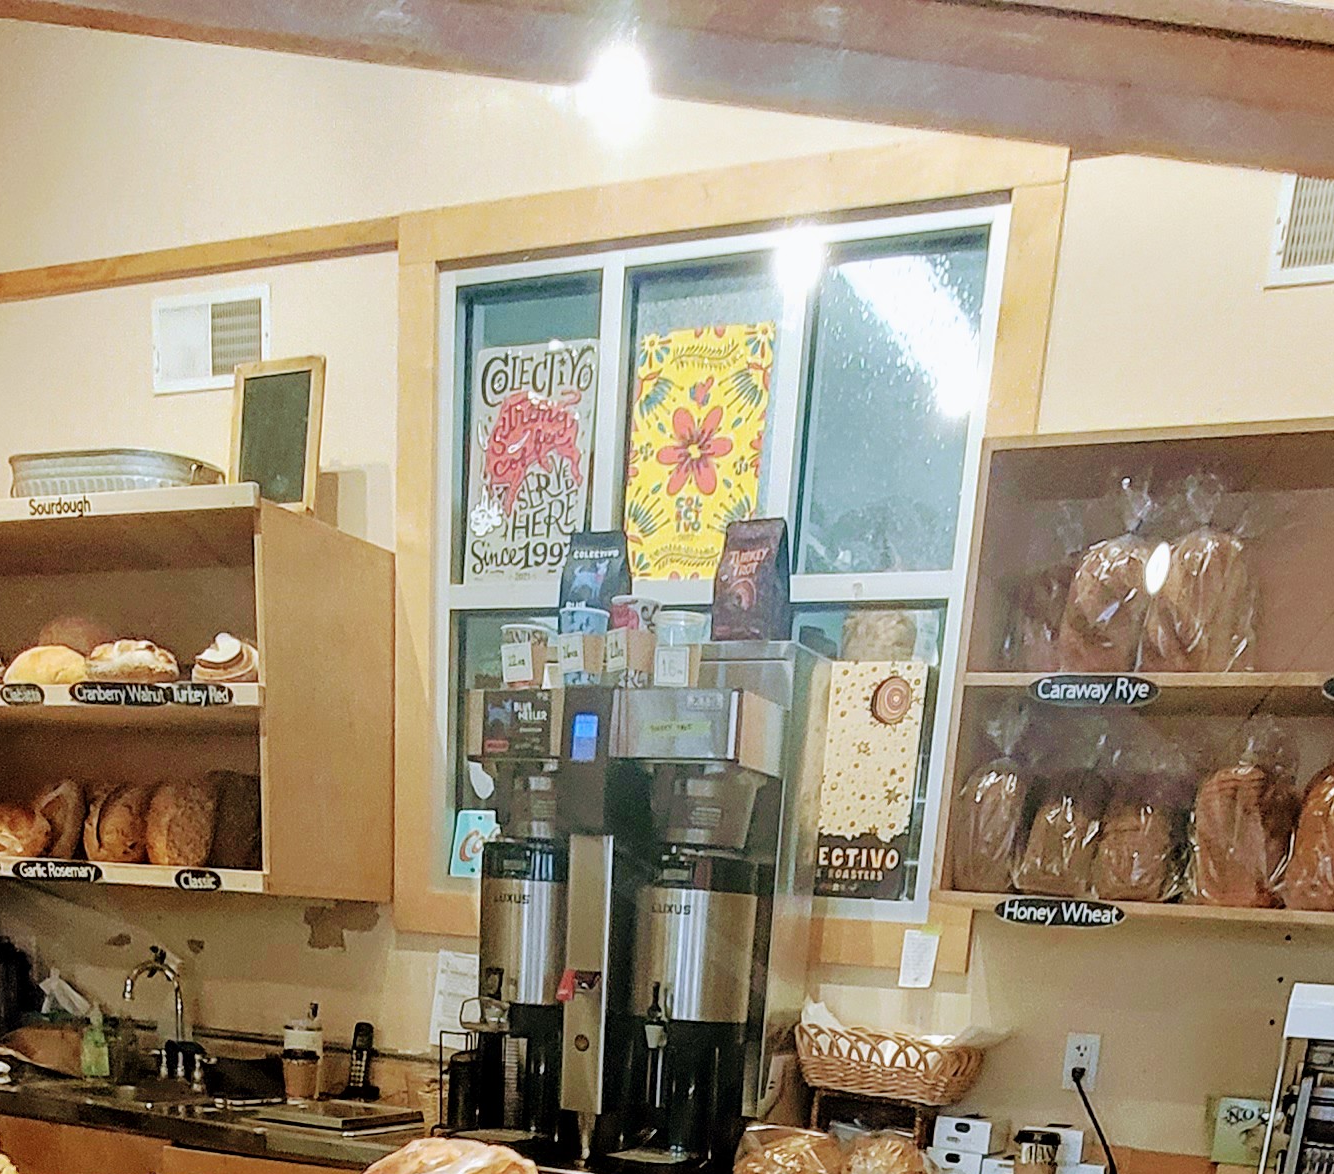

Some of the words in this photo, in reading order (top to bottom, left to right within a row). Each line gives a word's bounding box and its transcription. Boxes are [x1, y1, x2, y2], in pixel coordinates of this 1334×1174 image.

[28, 496, 92, 518] Sourdough
[511, 488, 578, 542] HERE
[471, 539, 524, 575] Since
[74, 684, 125, 704] Cranberry
[171, 684, 207, 706] Turkey
[209, 684, 230, 702] Red
[1037, 679, 1113, 704] Caraway
[1115, 678, 1150, 703] Rye
[49, 863, 96, 882] Rosemary
[179, 873, 217, 890] Classic
[1003, 900, 1058, 926] Honey
[1061, 902, 1119, 925] Wheat
